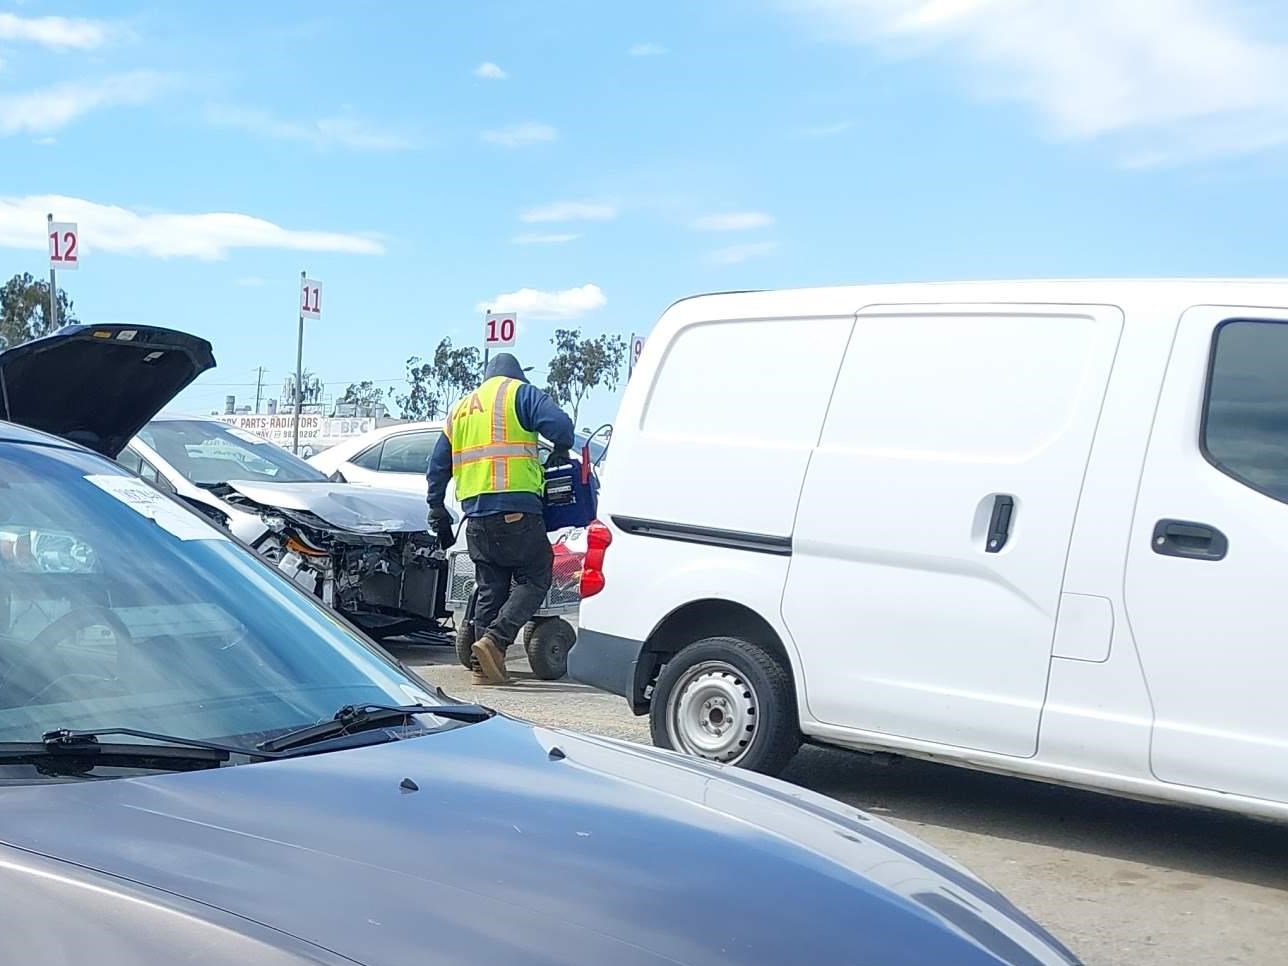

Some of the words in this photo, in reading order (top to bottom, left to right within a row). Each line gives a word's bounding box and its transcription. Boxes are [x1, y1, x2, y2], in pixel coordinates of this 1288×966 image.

[50, 231, 78, 262] 12
[301, 285, 322, 313] 11
[486, 319, 515, 342] 10
[240, 416, 319, 429] PARTS-RADIAORS
